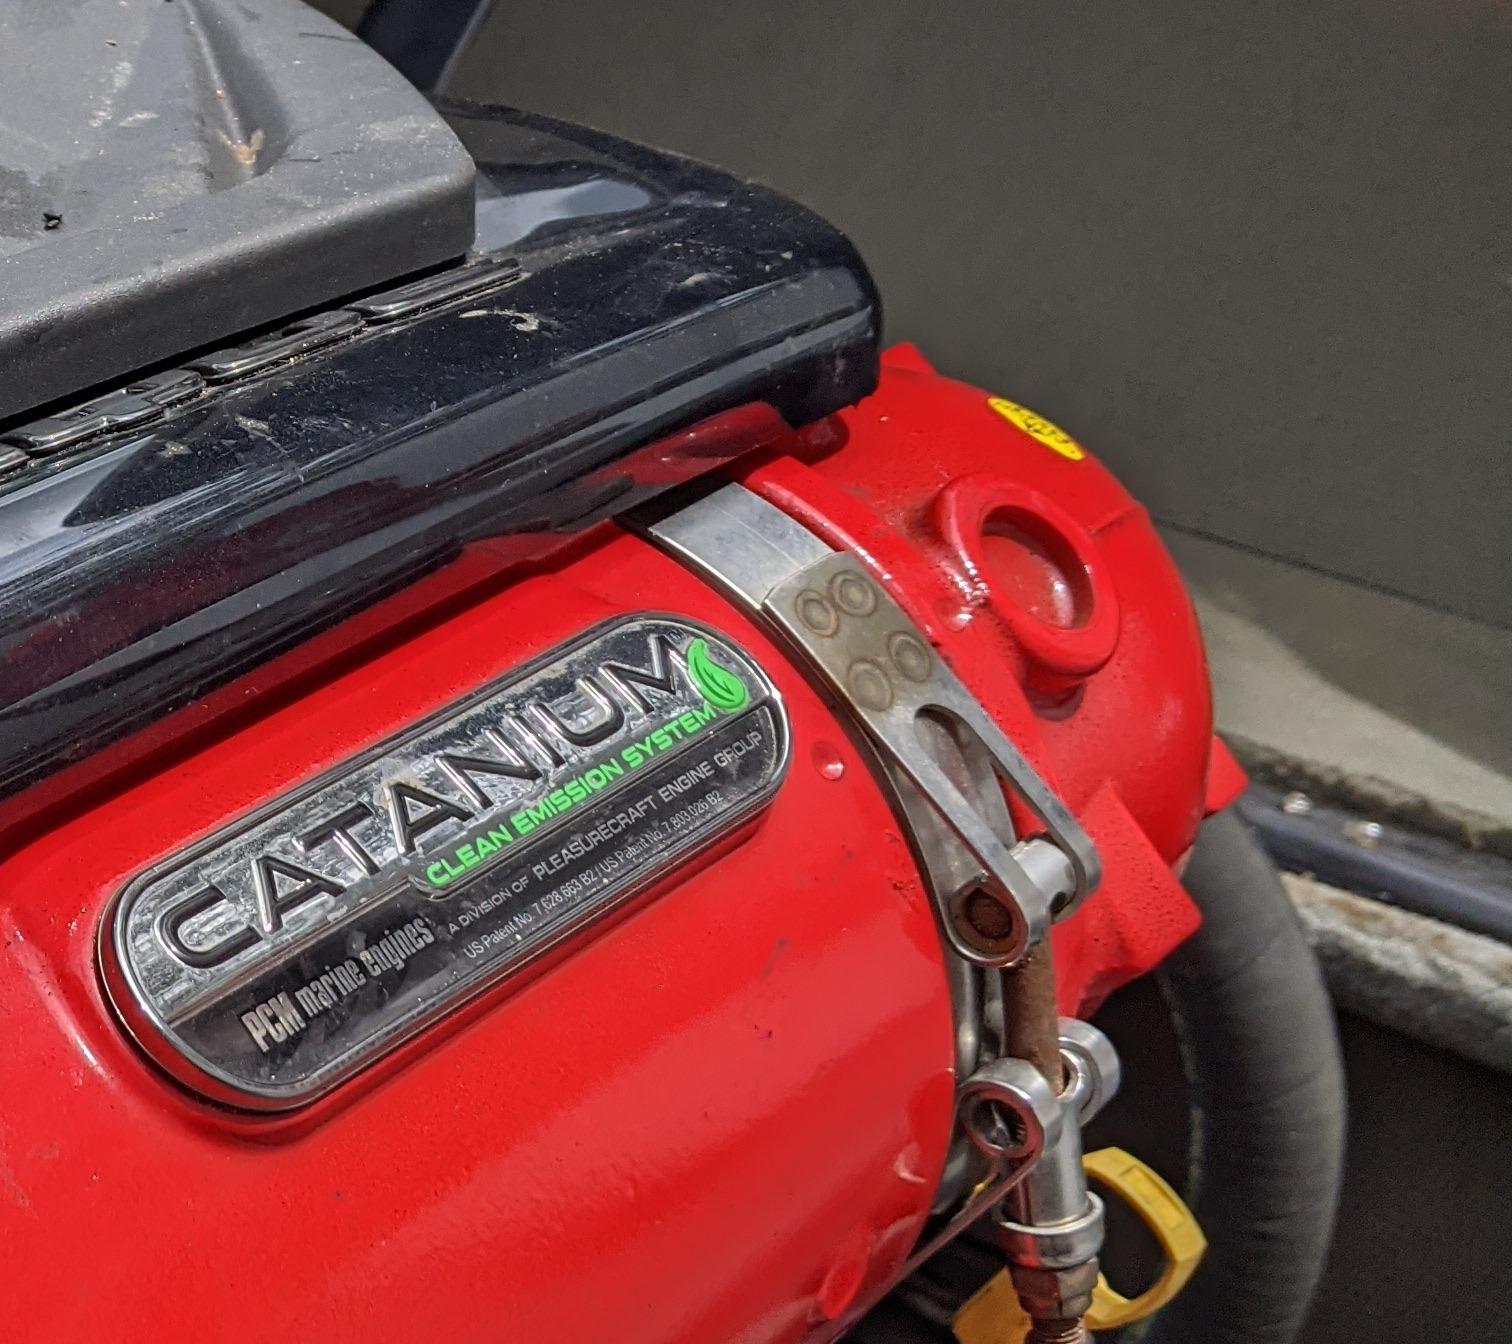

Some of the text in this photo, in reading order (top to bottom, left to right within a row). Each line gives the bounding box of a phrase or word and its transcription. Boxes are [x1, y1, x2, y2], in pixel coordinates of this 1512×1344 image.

[152, 634, 704, 969] CATANIUM
[423, 697, 720, 890] CLEAN EMISSION SYSTEM
[446, 728, 764, 934] A DIVISION OF PLEASURECRAFT ENGINE GROUP
[462, 938, 485, 960] US
[480, 917, 518, 948] Patent
[578, 867, 597, 886] B2
[598, 854, 618, 873] US
[614, 835, 649, 863] Patent
[706, 788, 724, 806] B2
[239, 910, 440, 1054] PCM marine engines
